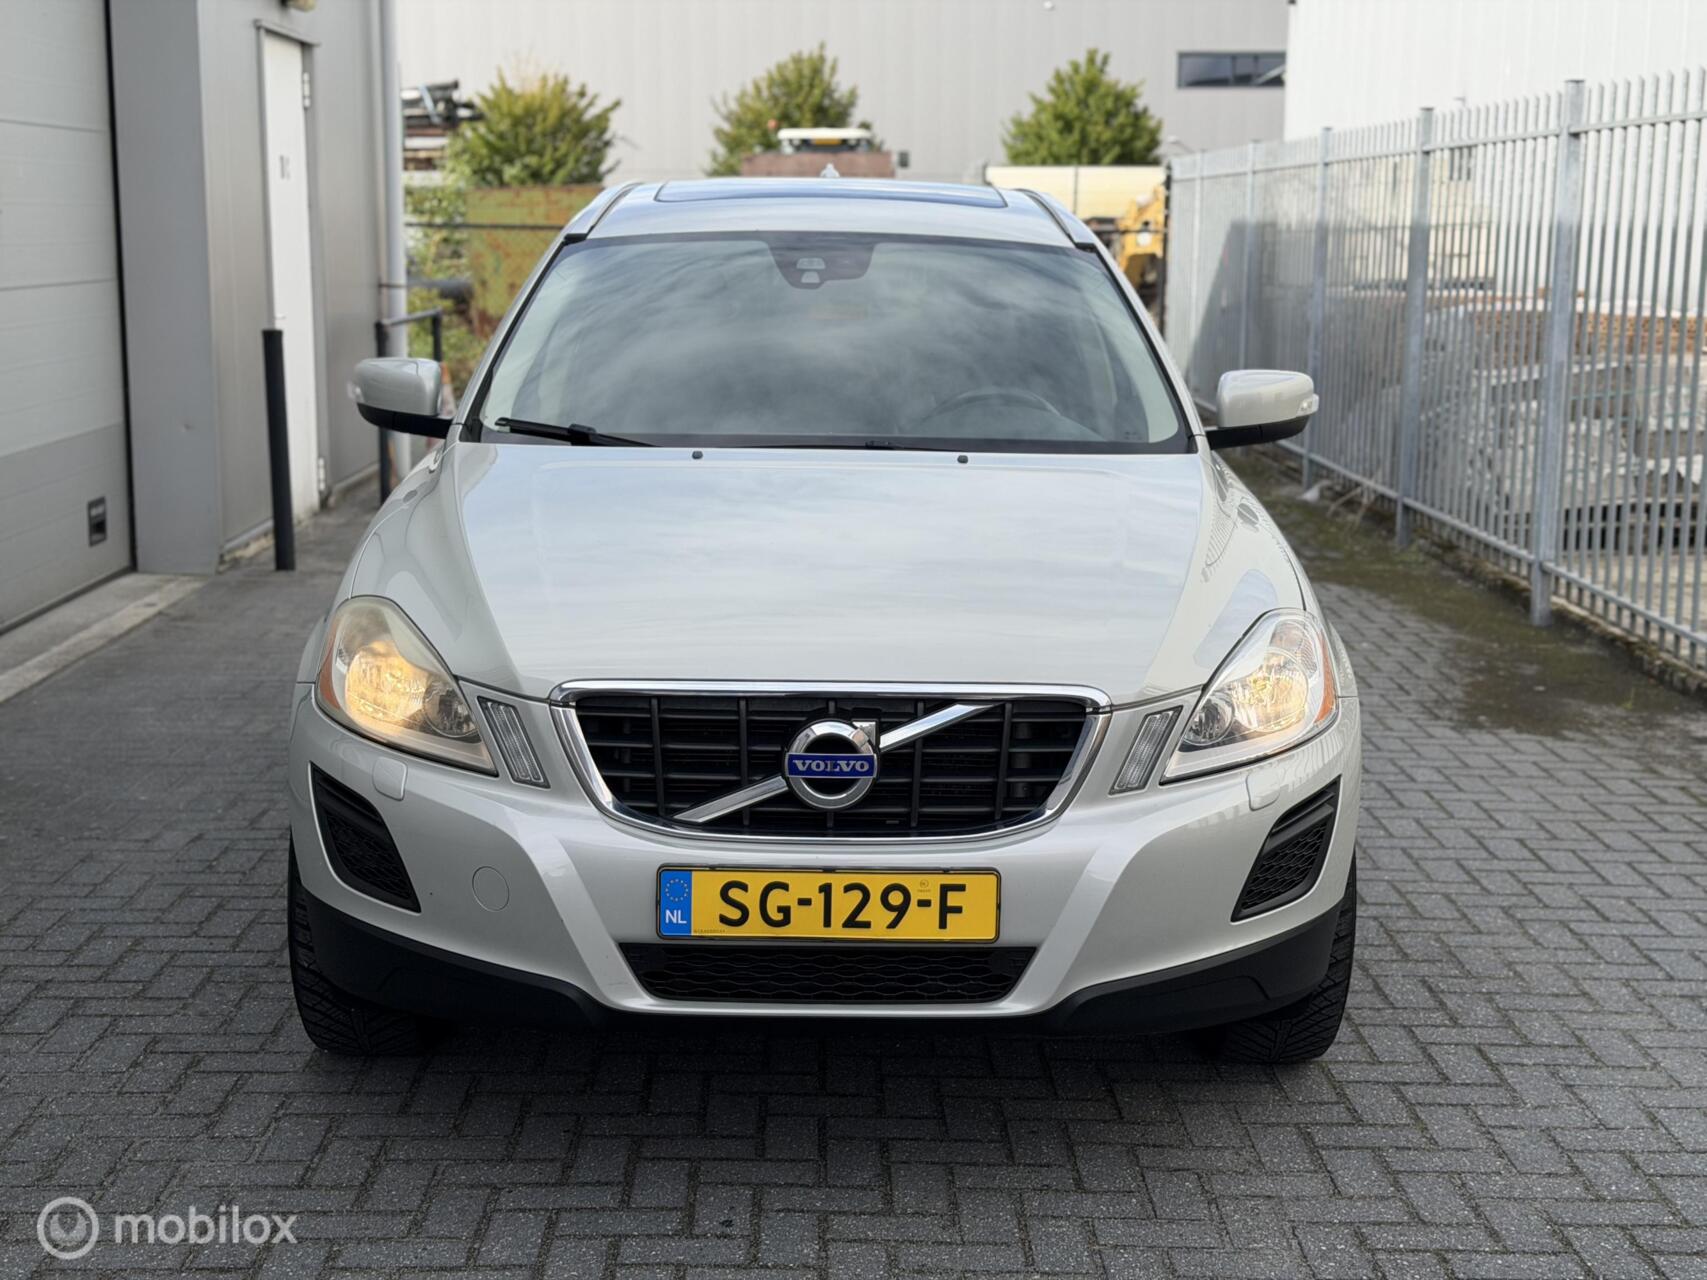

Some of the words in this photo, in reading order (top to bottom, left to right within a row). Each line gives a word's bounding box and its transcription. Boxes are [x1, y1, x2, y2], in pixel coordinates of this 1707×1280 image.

[793, 760, 869, 772] VOLVO
[719, 880, 966, 930] SG-129-F
[665, 909, 687, 924] NL
